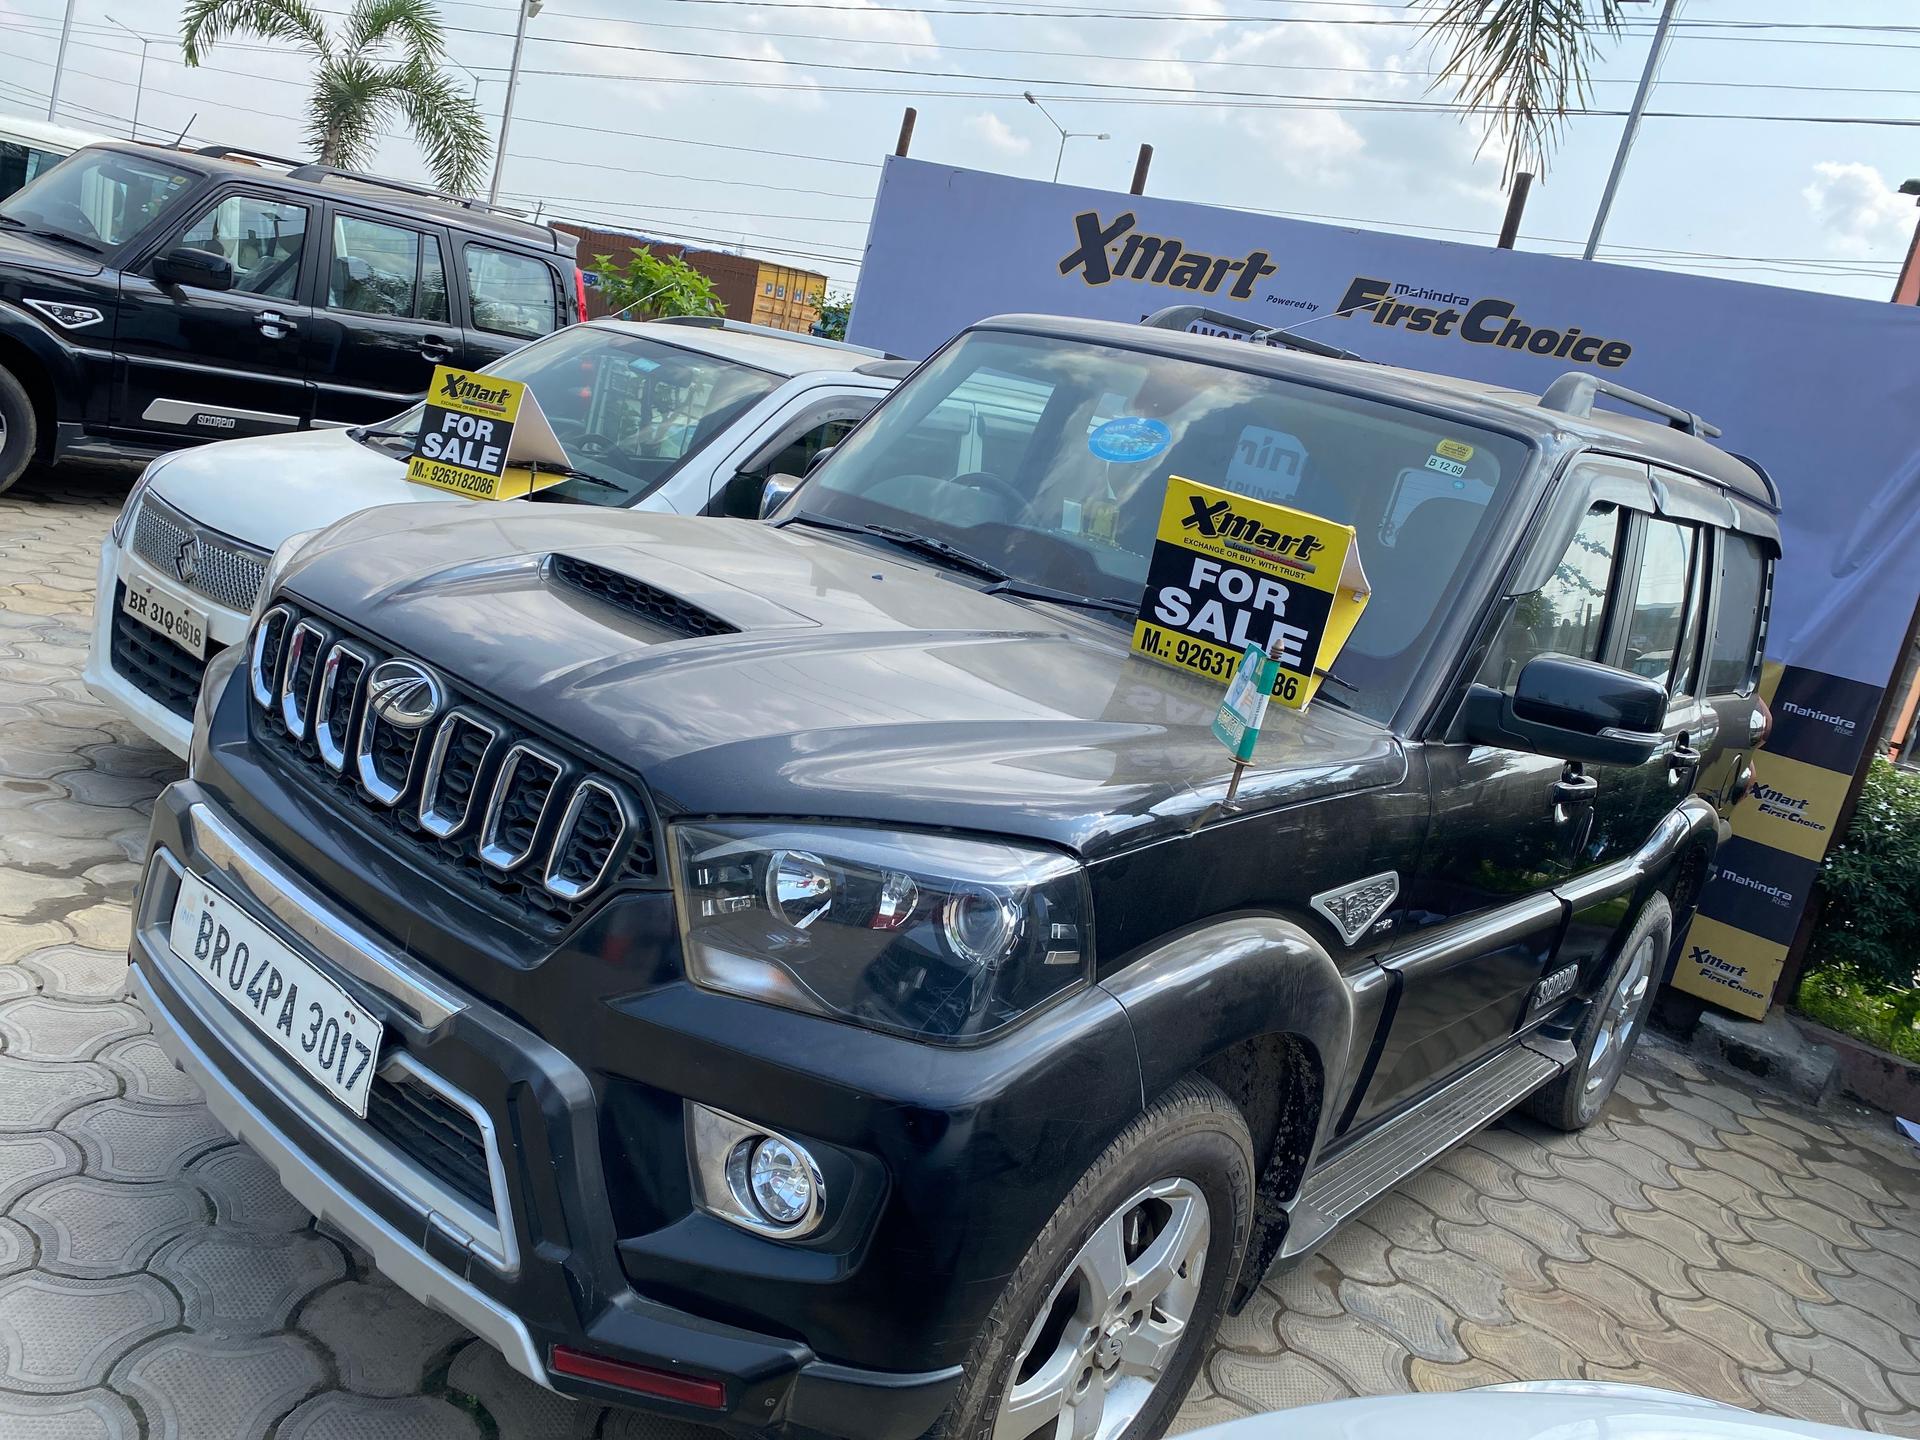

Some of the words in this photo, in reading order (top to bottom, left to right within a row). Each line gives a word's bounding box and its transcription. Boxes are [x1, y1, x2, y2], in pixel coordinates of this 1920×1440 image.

[1265, 293, 1305, 309] Powered
[1306, 301, 1319, 313] by
[196, 414, 236, 429] SCORPIO
[442, 412, 494, 443] FOR
[421, 432, 502, 473] SALE
[1428, 458, 1438, 467] B
[1439, 461, 1451, 471] 12
[1451, 465, 1464, 475] 09
[431, 466, 495, 495] 9263182086
[1183, 536, 1225, 556] EXCHANGE
[1226, 549, 1238, 559] OR
[1258, 559, 1278, 571] WITH
[1188, 557, 1290, 618] FOR
[128, 590, 148, 616] BR
[175, 616, 202, 648] 6818
[1154, 586, 1309, 667] SALE
[1174, 638, 1298, 702] 9263186
[193, 909, 298, 1038] BR04PA
[301, 1002, 371, 1092] 3017
